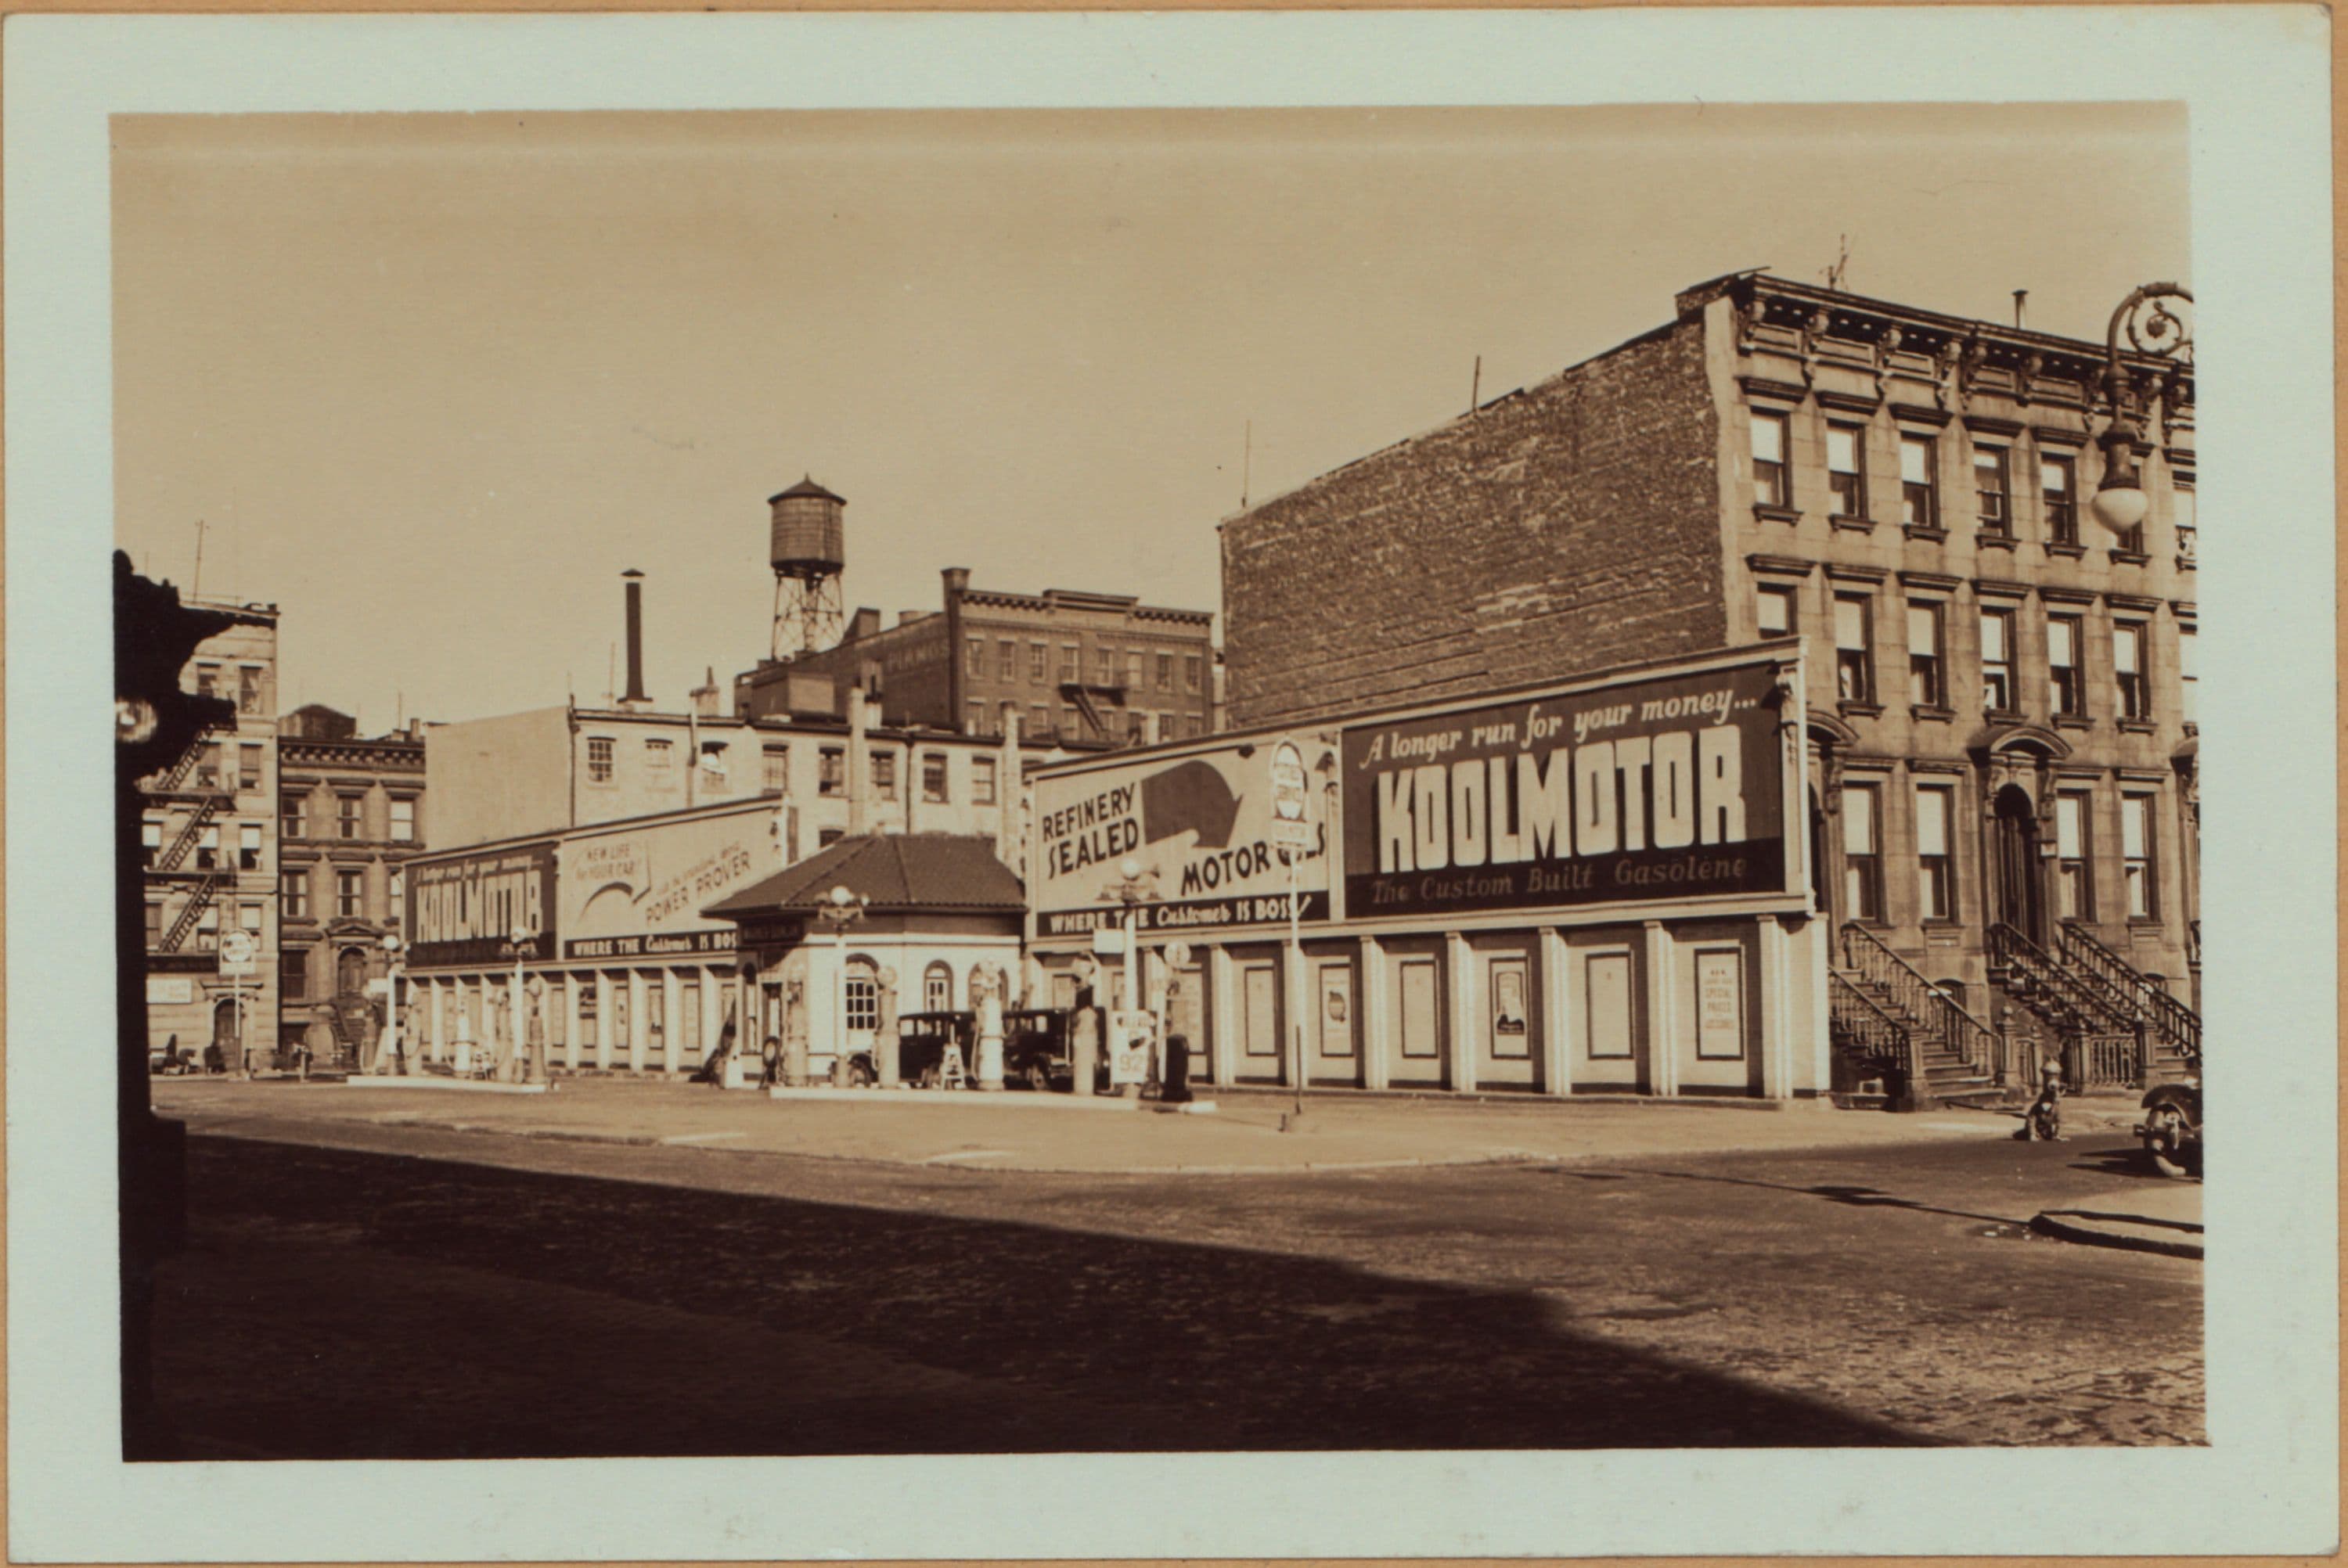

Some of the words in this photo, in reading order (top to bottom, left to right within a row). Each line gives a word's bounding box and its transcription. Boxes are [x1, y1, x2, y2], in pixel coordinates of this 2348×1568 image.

[1359, 730, 1383, 768] A
[1390, 728, 1463, 763] longer
[1471, 722, 1516, 748] run
[1521, 704, 1563, 749] for
[1573, 704, 1633, 743] your
[1641, 689, 1757, 725] money...
[1042, 781, 1135, 843] REFINERY
[1377, 725, 1748, 874] KOOLMOTOR
[610, 843, 630, 860] LIFE
[1048, 817, 1139, 880] SEALED
[1180, 840, 1271, 897] MOTOR
[416, 869, 543, 944] KOOLMOTOR
[645, 885, 690, 926] POWER
[696, 850, 751, 899] PROVER
[1370, 879, 1410, 904] The
[1421, 871, 1514, 900] Custom
[1525, 864, 1594, 894] Built
[1614, 856, 1747, 887] Gasolene
[574, 939, 613, 956] WHERE
[617, 937, 640, 954] THE
[699, 933, 710, 950] IS
[1050, 911, 1107, 933] WHERE
[1114, 908, 1150, 930] TE
[1157, 903, 1232, 927] Customer
[1237, 901, 1251, 921] IS
